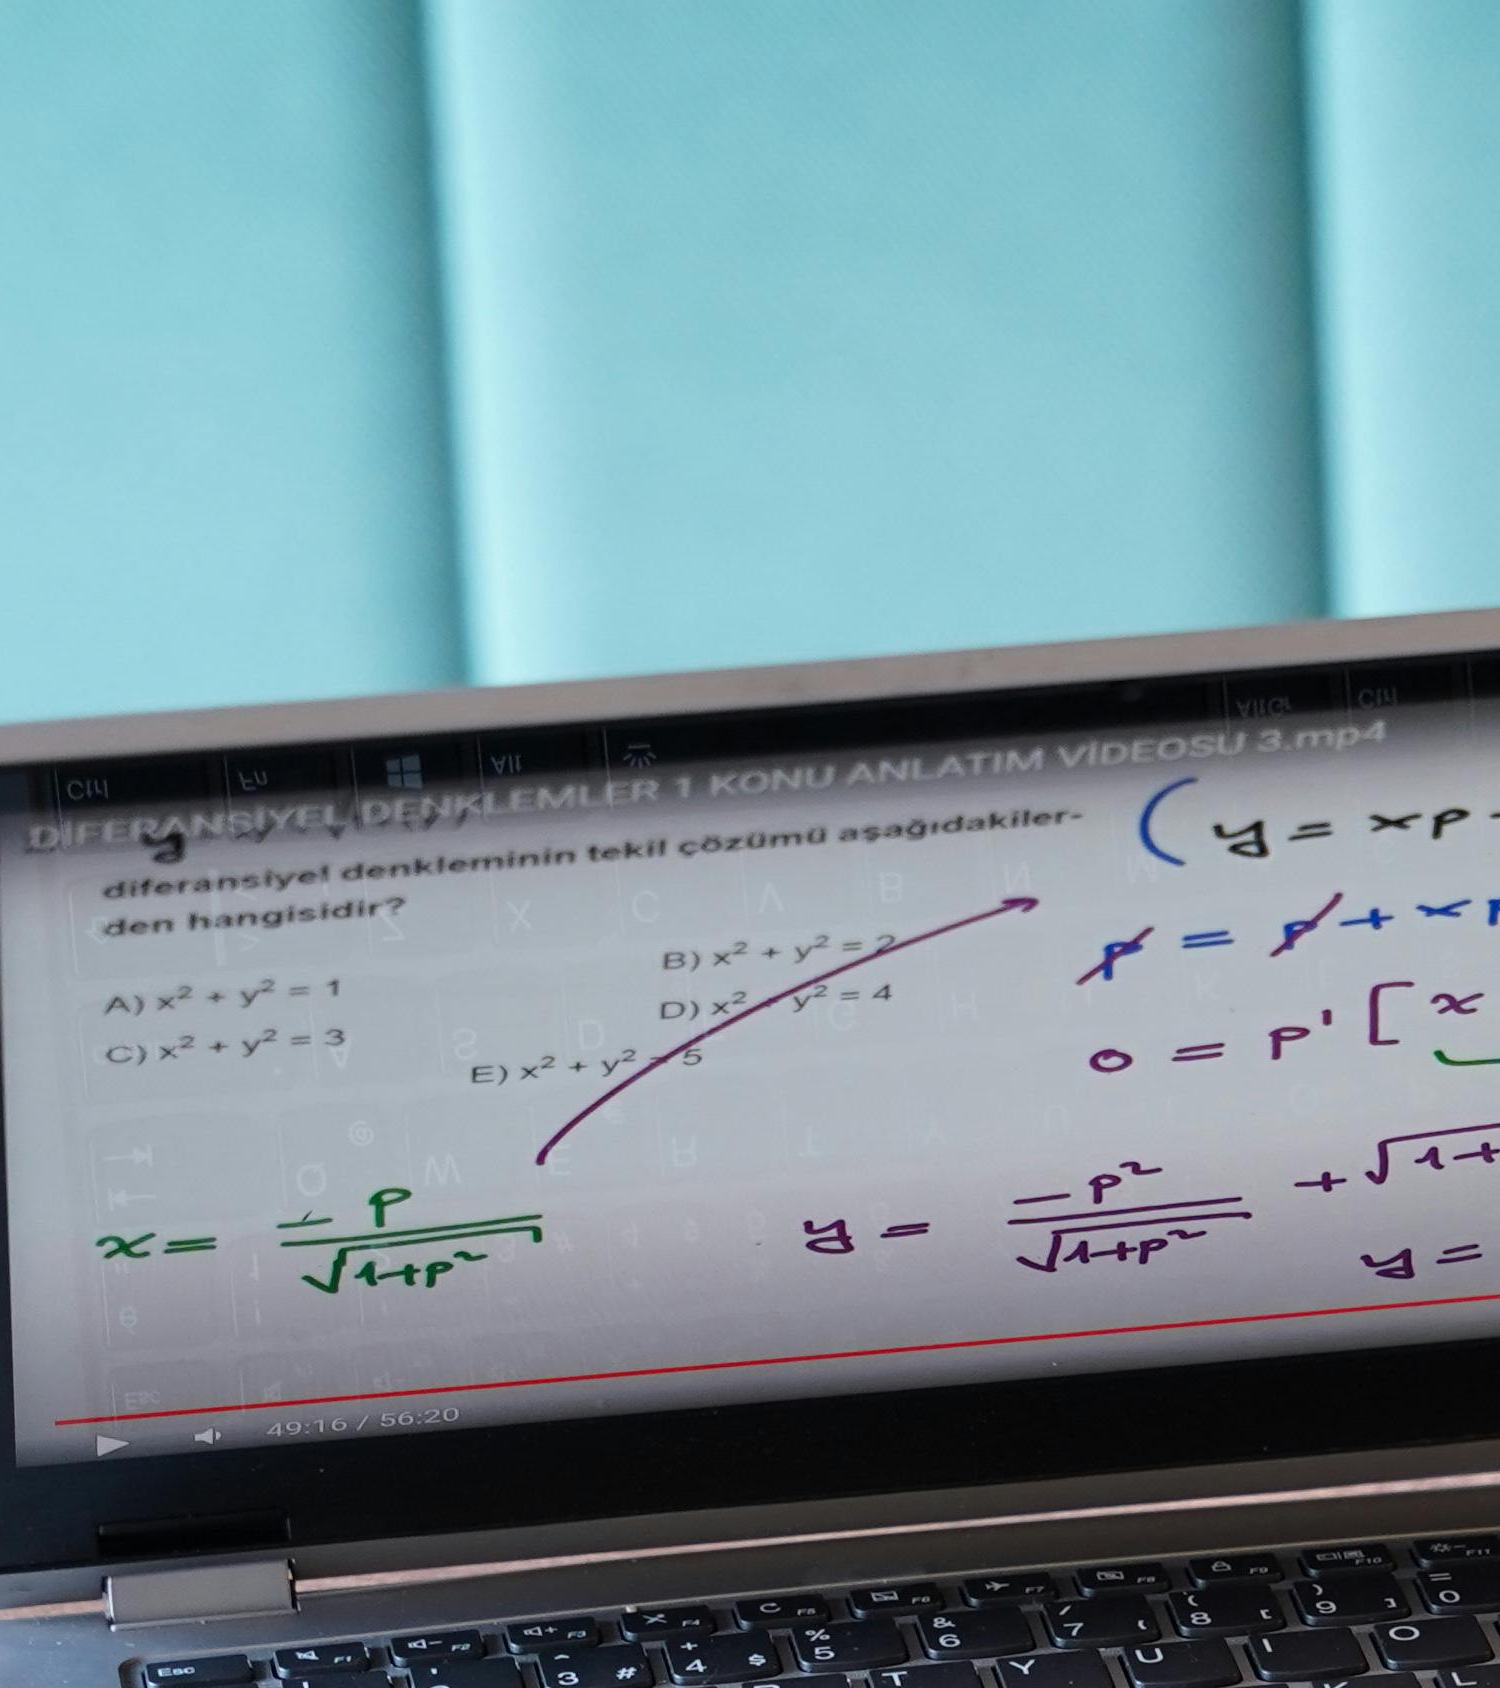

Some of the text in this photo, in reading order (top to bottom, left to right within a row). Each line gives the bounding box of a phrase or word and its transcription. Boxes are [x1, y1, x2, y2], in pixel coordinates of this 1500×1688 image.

[675, 776, 691, 798] 1
[709, 765, 836, 798] KONU
[1057, 728, 1246, 769] VİDEOSU
[1257, 718, 1388, 753] 3.mp4
[103, 807, 1084, 900] diferansiyel denkleminin tekil çözümü aşağıdakiler-
[103, 896, 407, 938] den hangisidir?
[661, 950, 701, 974] B)
[103, 995, 146, 1016] A)
[659, 1000, 700, 1024] D)
[871, 984, 894, 1003] 4
[104, 1044, 148, 1066] C)
[323, 1028, 346, 1048] 3
[470, 1065, 509, 1087] E)
[682, 1048, 703, 1068] 5
[266, 1404, 462, 1440] 49:16 56:20
[157, 1663, 196, 1679] Esc
[332, 1652, 355, 1665] F1
[449, 1641, 473, 1654] F2
[565, 1628, 589, 1641] F3
[680, 1617, 703, 1629] F4
[796, 1606, 818, 1617] F5
[1024, 1584, 1047, 1595] F7
[1248, 1565, 1270, 1576] F9
[1354, 1556, 1384, 1567] F10
[1464, 1546, 1493, 1557] F11
[556, 1670, 581, 1687] 3
[685, 1658, 707, 1675] 4
[812, 1645, 836, 1662] 5
[938, 1632, 963, 1648] 6
[1063, 1621, 1086, 1638] 7
[1190, 1611, 1213, 1627] 8
[1315, 1599, 1338, 1616] 9
[880, 1670, 909, 1688] T
[1007, 1658, 1038, 1675] Y
[1134, 1647, 1166, 1665] U
[1451, 1671, 1479, 1688] L
